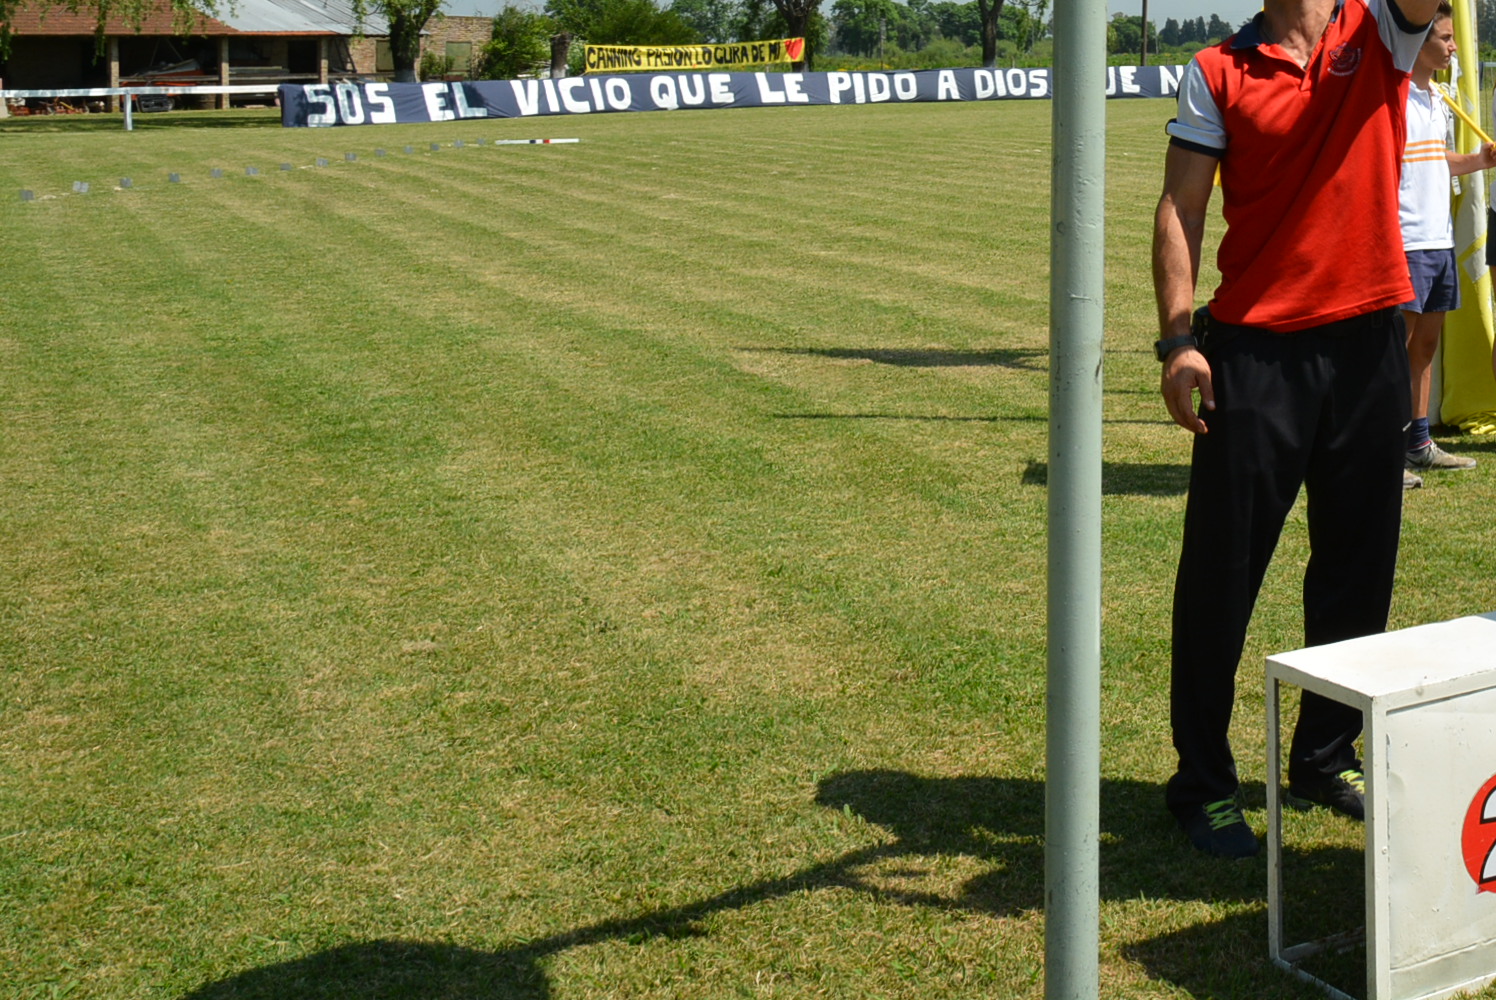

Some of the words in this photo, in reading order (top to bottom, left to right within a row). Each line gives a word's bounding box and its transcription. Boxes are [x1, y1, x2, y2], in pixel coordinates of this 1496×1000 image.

[587, 47, 642, 69] CANNING
[646, 47, 692, 67] PASION
[751, 43, 765, 62] DE
[768, 41, 780, 61] MI
[303, 82, 397, 128] SOS
[421, 81, 488, 122] EL
[509, 75, 631, 116] VICIO
[650, 73, 734, 111] QUE
[755, 71, 809, 104] LE
[827, 71, 917, 104] PIDO
[937, 69, 960, 100] A
[974, 68, 1048, 99] DIOS
[1105, 65, 1141, 96] UE
